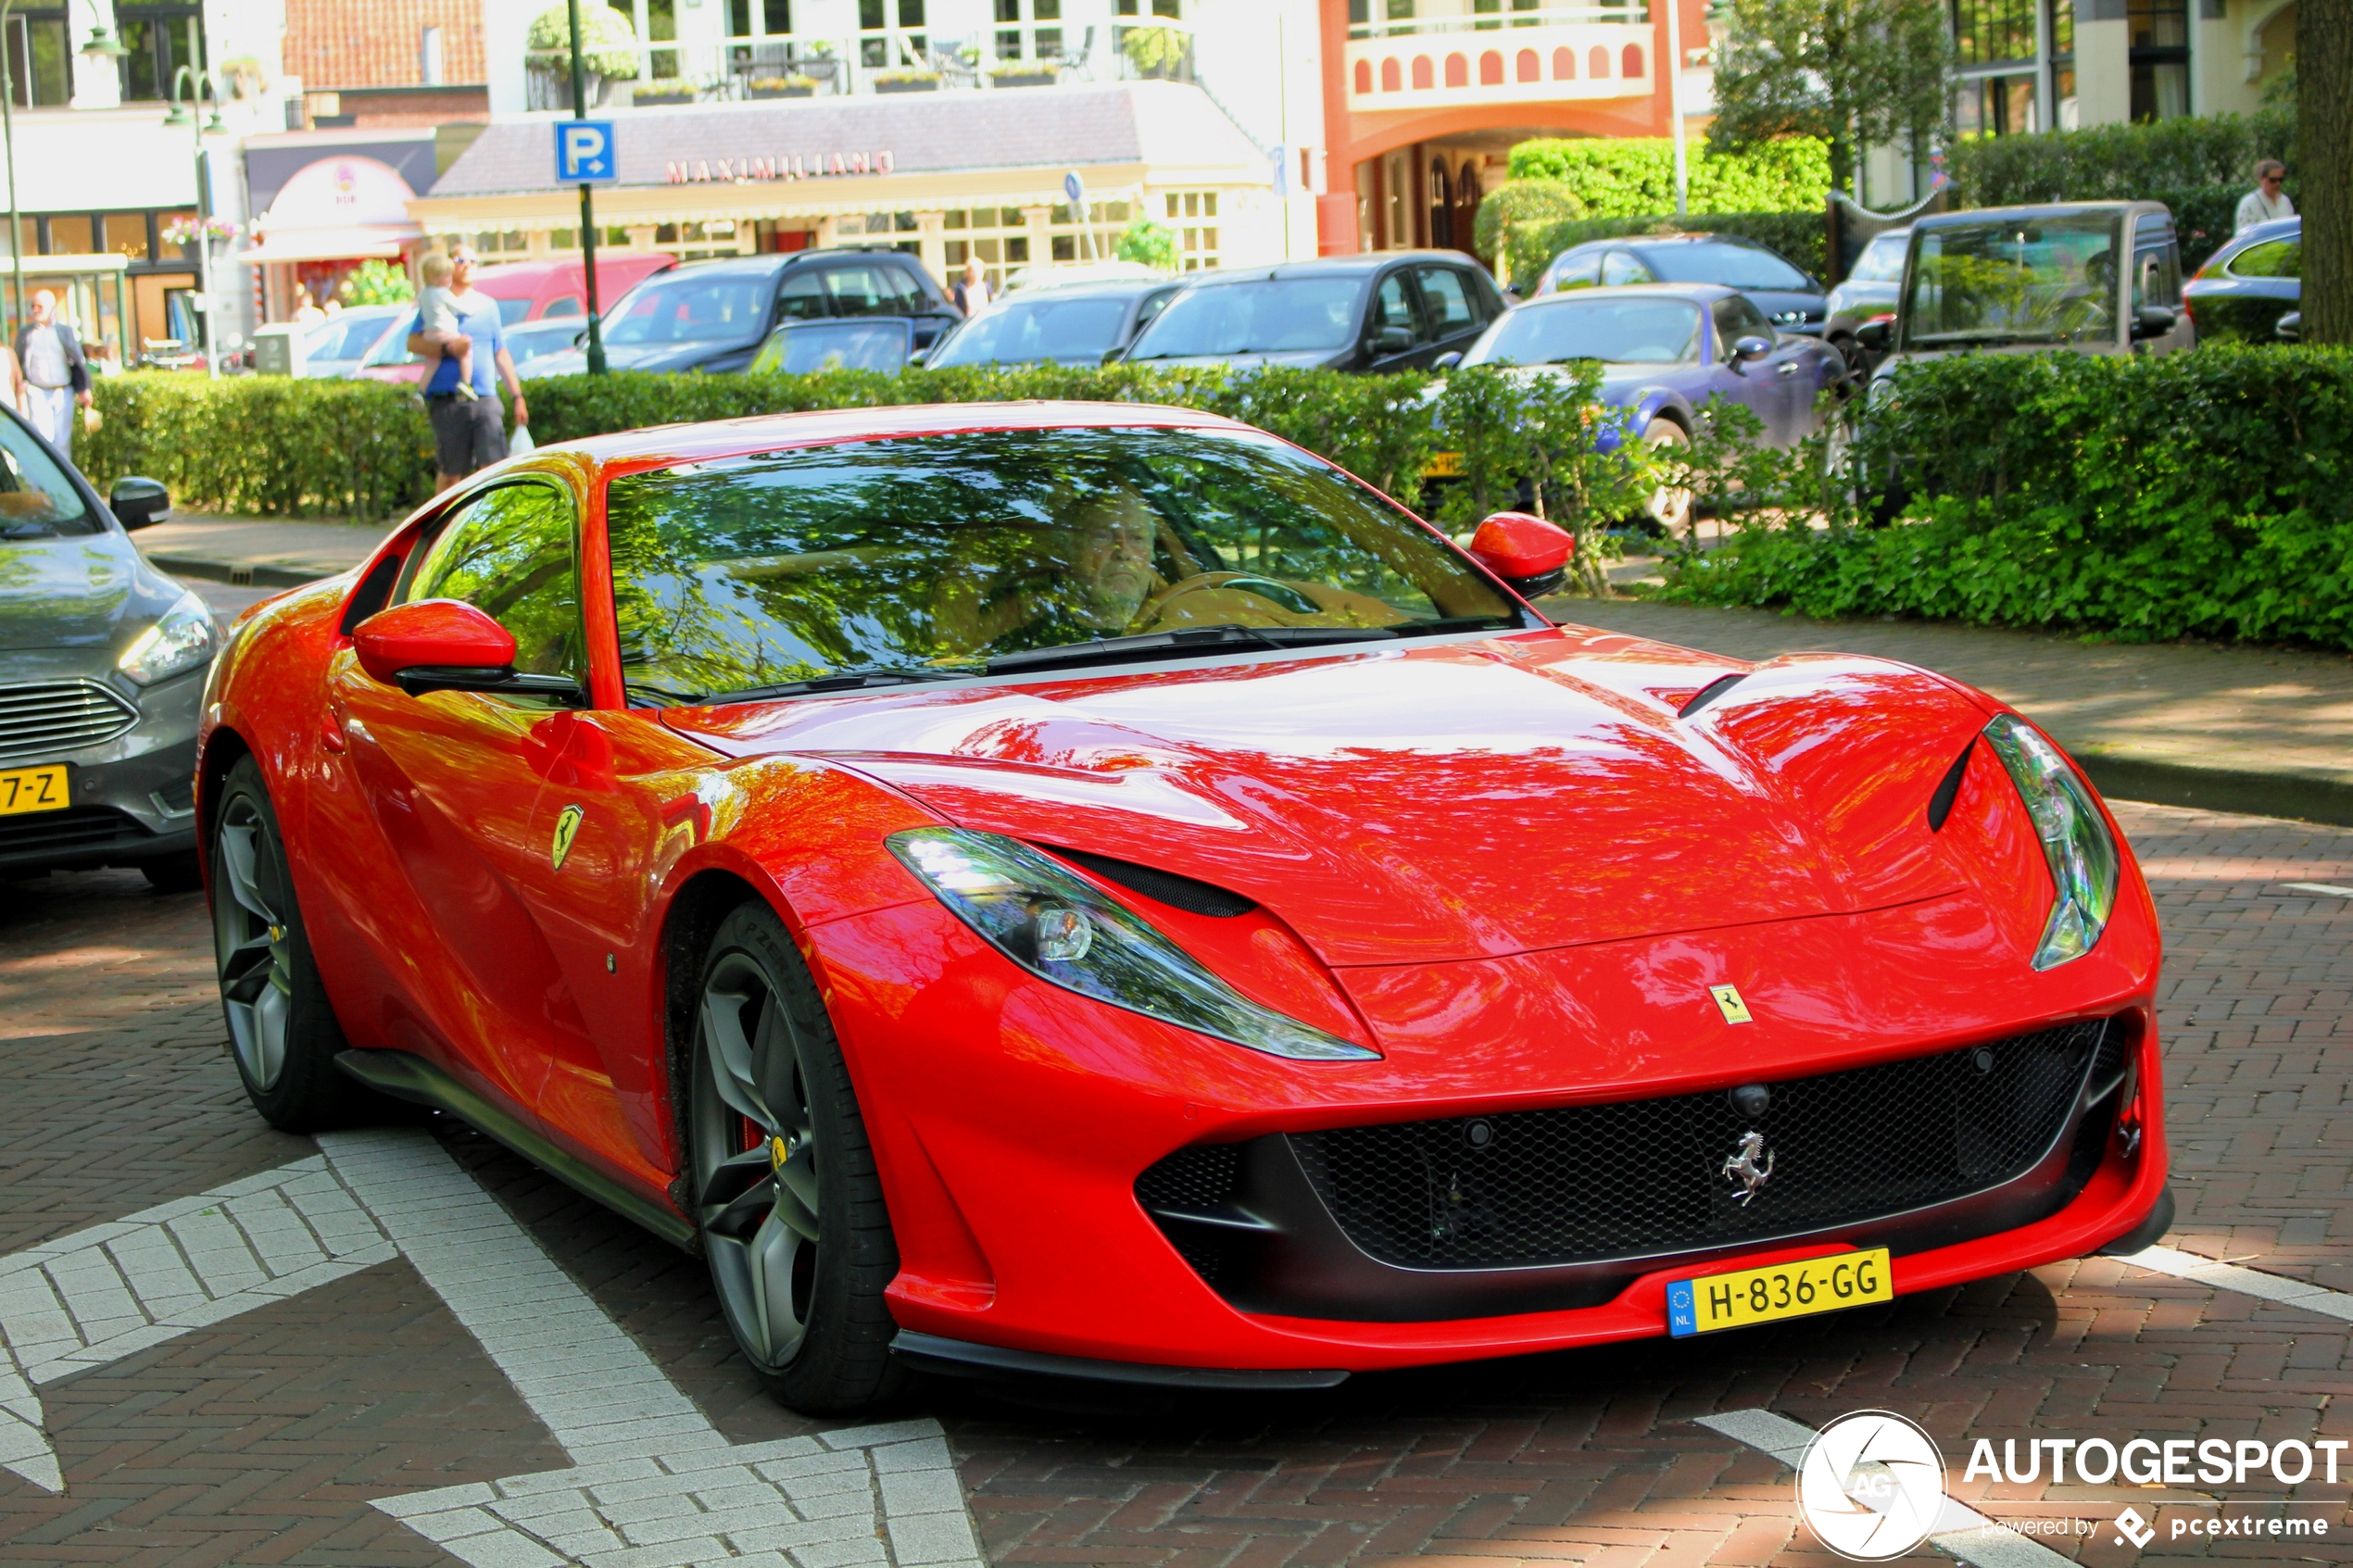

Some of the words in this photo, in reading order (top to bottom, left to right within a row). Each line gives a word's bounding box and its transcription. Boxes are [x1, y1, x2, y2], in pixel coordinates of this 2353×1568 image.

[566, 128, 604, 175] P
[666, 149, 895, 183] MAXIMILIANO
[0, 773, 56, 808] 7-Z
[1709, 1260, 1878, 1320] H-836-GG
[1675, 1314, 1692, 1326] NL
